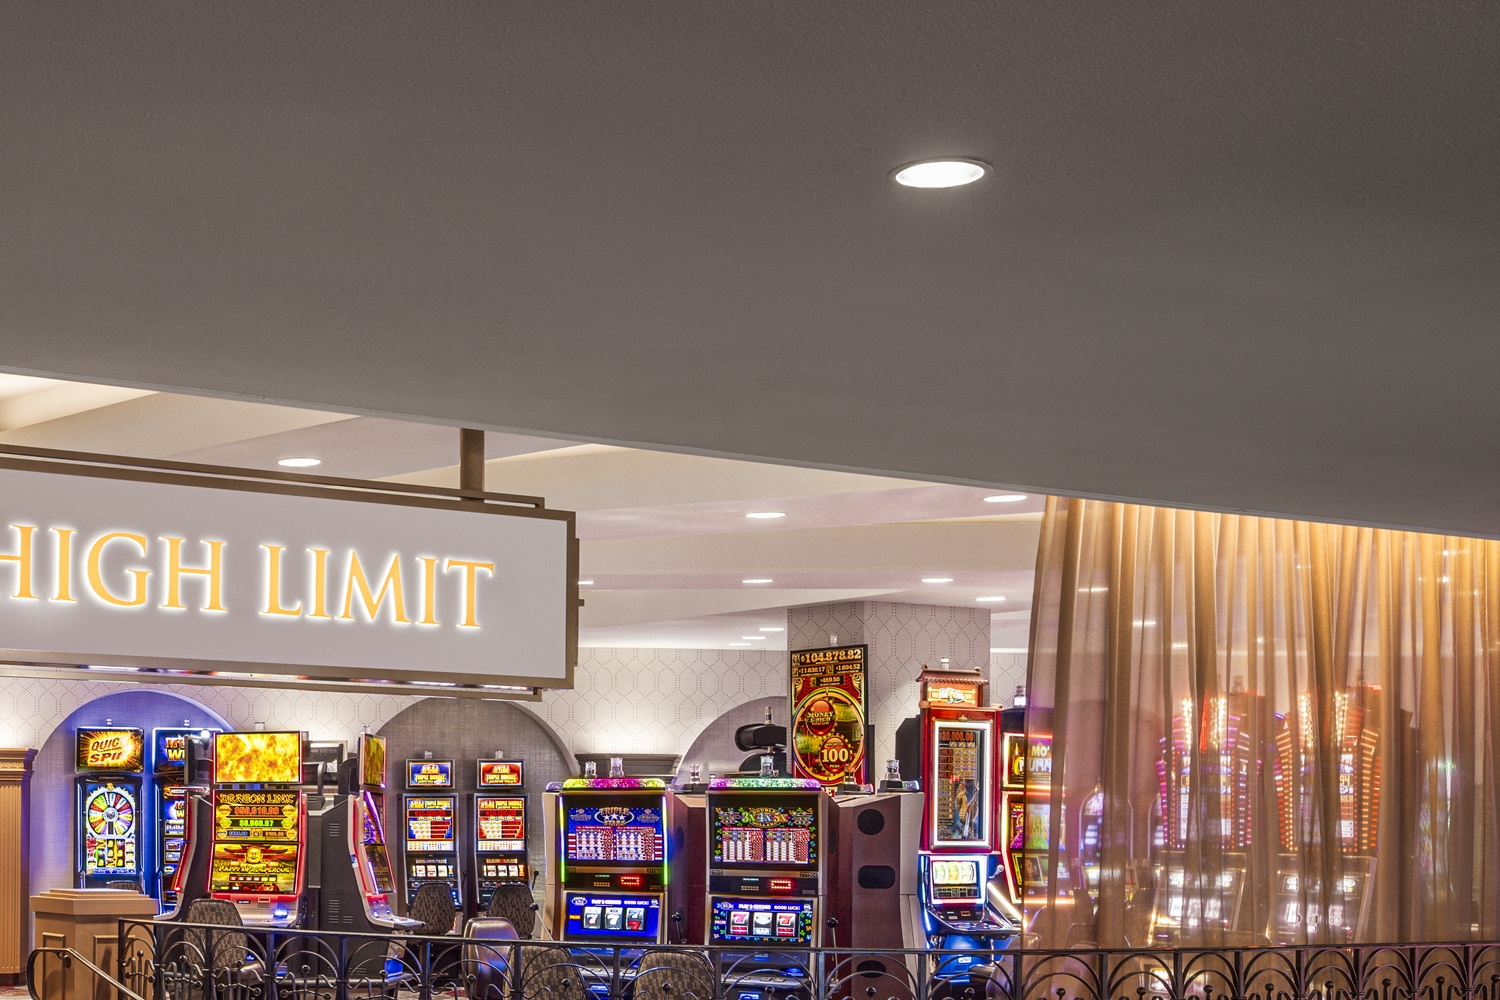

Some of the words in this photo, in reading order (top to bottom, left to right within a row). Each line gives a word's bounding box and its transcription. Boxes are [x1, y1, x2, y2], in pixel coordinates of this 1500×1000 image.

[258, 543, 496, 629] LIMIT
[821, 748, 849, 763] 100
[220, 793, 266, 803] DRAGON
[267, 793, 294, 803] LINK
[599, 807, 629, 815] TRIPLE
[732, 913, 748, 923] 7
[778, 915, 794, 926] 7
